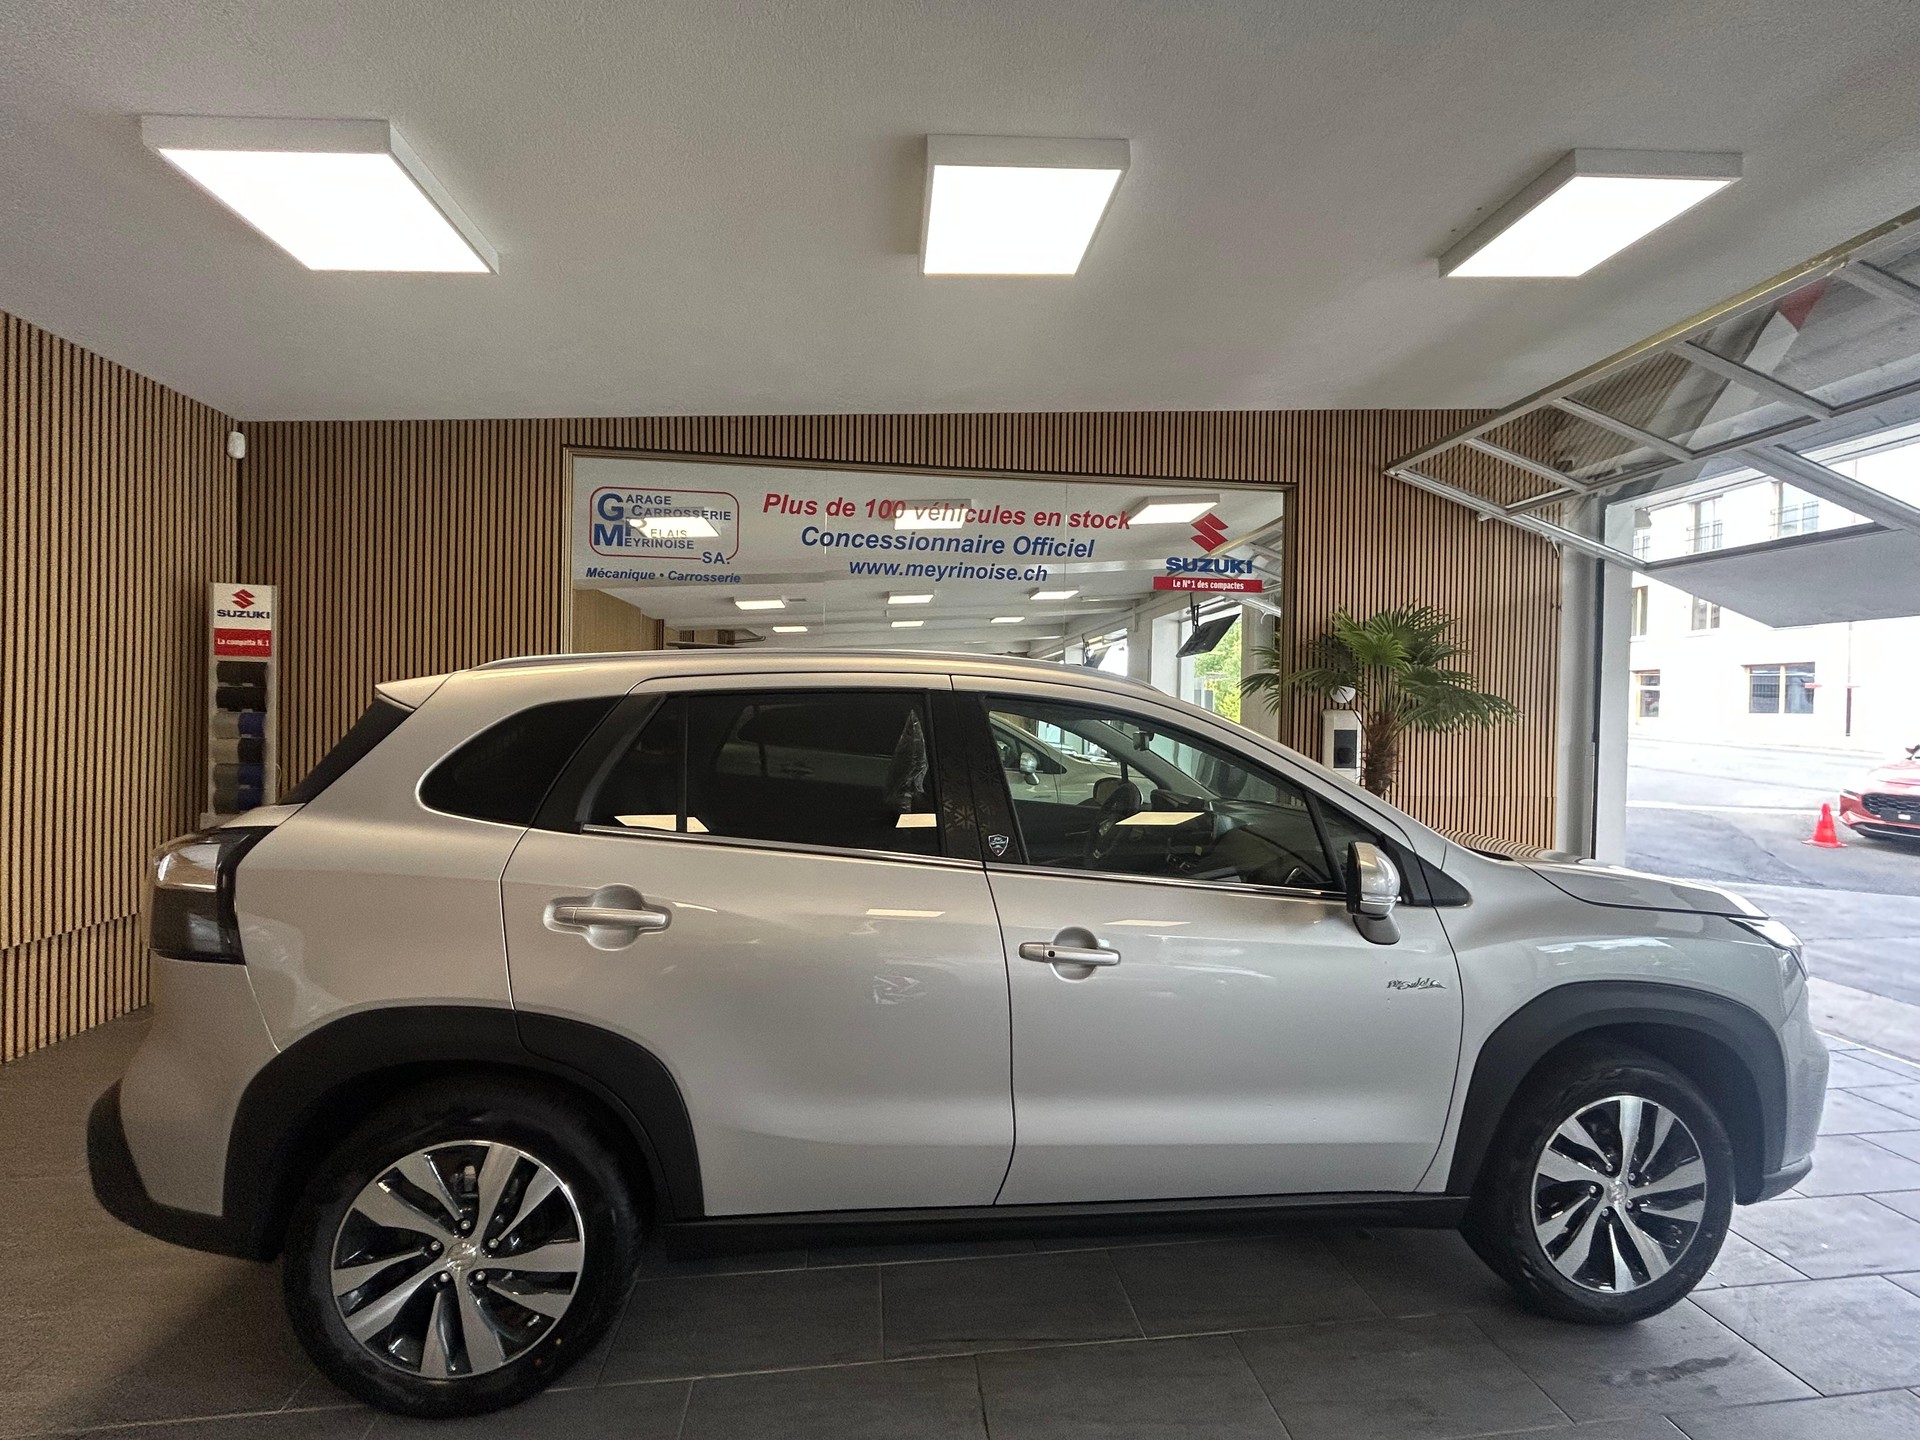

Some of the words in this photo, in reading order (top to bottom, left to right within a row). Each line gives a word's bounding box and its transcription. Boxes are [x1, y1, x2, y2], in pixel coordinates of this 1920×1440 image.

[631, 505, 731, 520] CARROSSERIE
[763, 493, 818, 515] Plus
[826, 497, 856, 517] de
[865, 499, 906, 519] 100
[914, 501, 1026, 525] véhicules
[1034, 511, 1062, 526] en
[1068, 510, 1131, 529] stock
[801, 526, 1005, 554] Concessionnaire
[1013, 535, 1095, 557] Officiel
[850, 561, 1048, 582] www.meyrinoise.ch
[1166, 557, 1252, 573] SUZUKI
[586, 567, 656, 582] Mécanique
[668, 570, 741, 583] Carrosserie
[1173, 580, 1181, 588] Le
[1197, 580, 1209, 589] des
[1210, 582, 1244, 590] compactes
[217, 609, 270, 619] SUZUKI
